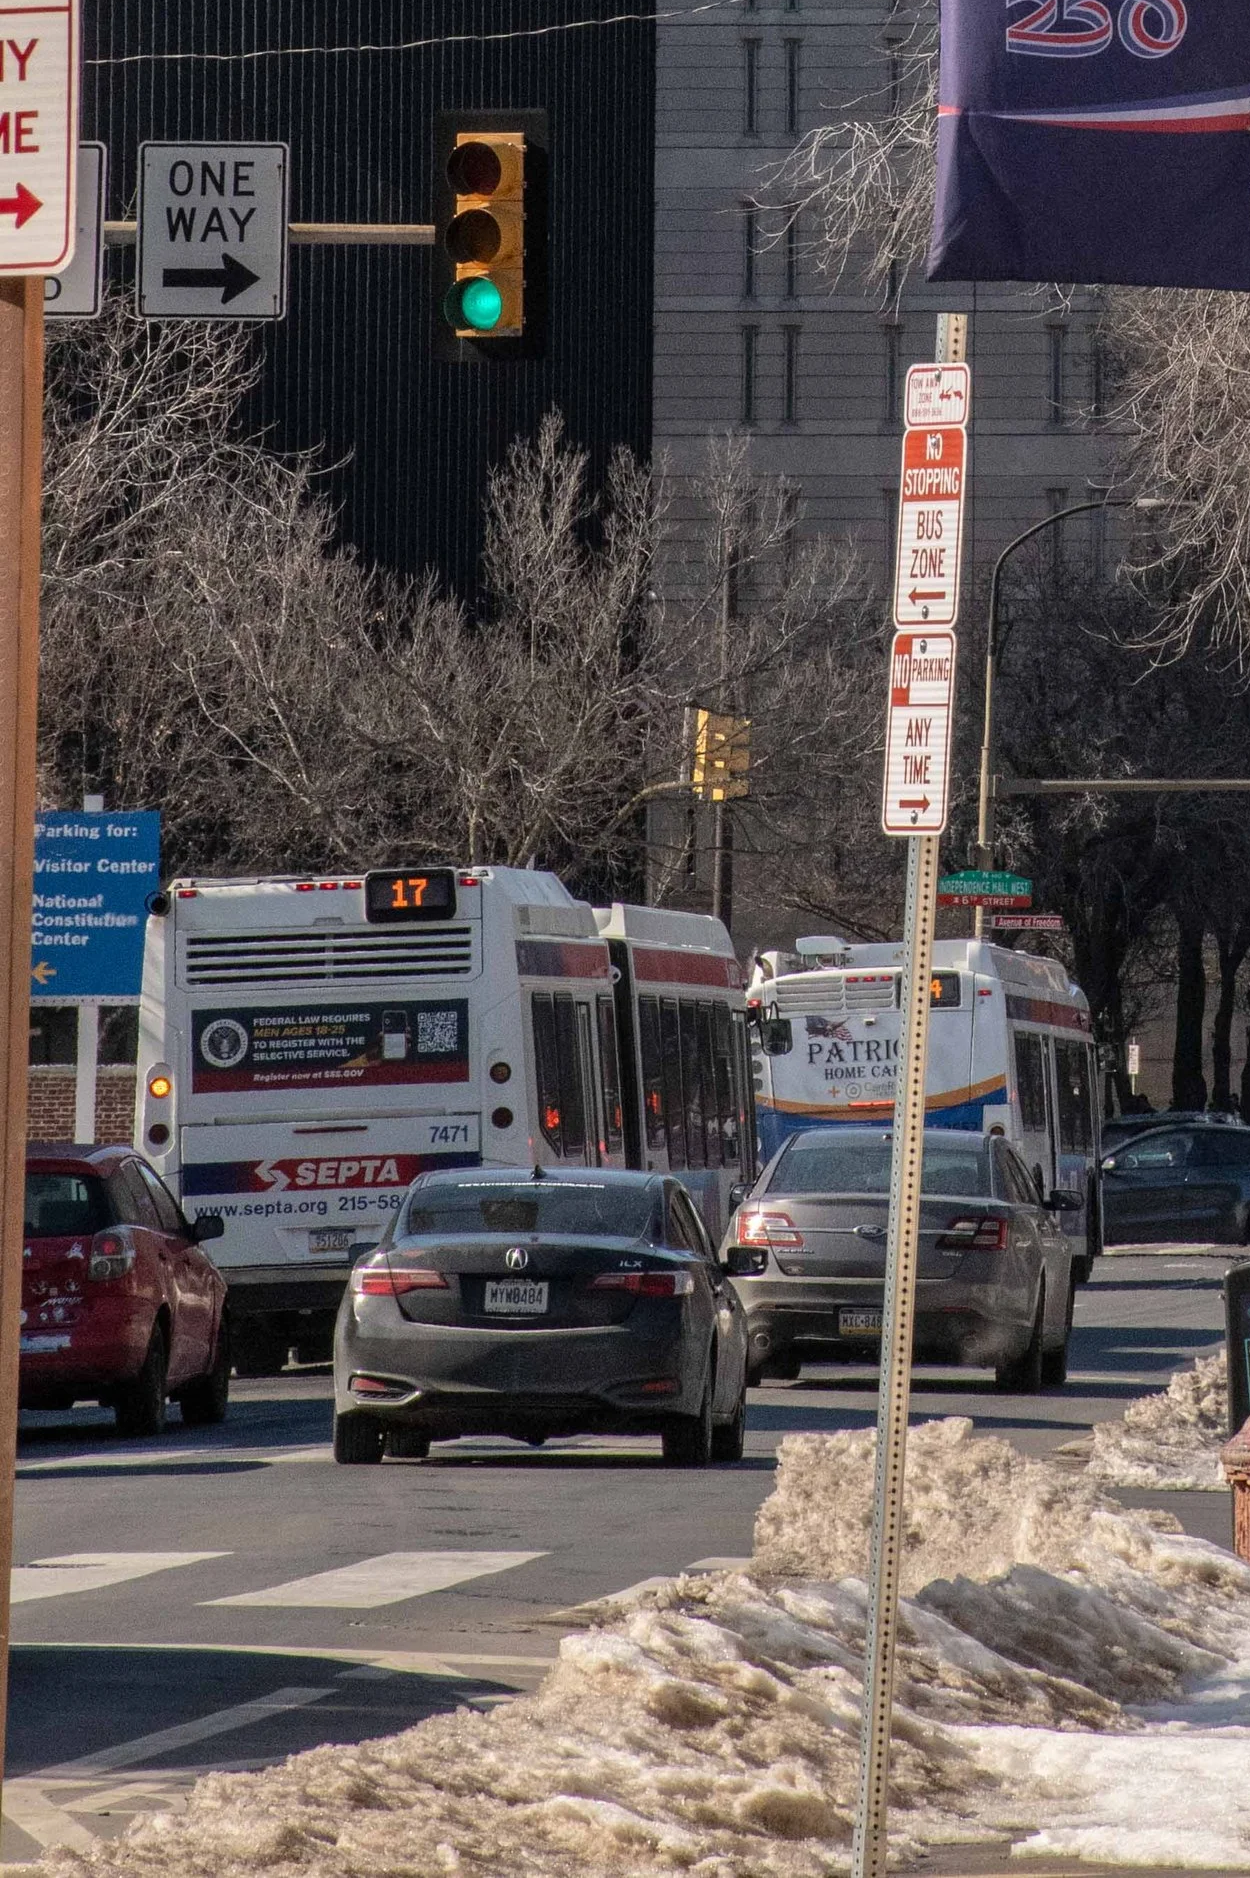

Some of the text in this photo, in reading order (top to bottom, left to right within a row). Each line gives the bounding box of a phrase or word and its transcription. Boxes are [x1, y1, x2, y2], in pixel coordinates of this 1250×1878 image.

[0, 39, 39, 82] Y
[168, 161, 255, 198] ONE
[166, 207, 257, 243] WAY
[926, 433, 943, 460] NO
[905, 467, 960, 496] STOPPING
[916, 510, 943, 540] BUS
[910, 548, 946, 578] ZONE
[893, 653, 909, 689] NO
[912, 657, 950, 682] PARKING
[905, 718, 932, 747] ANY
[903, 755, 931, 784] TIME
[33, 824, 137, 839] Parking for:
[33, 859, 155, 873] Visitor Center
[392, 878, 427, 907] 17
[938, 881, 1028, 894] INDEPENDENCE MALL WEST
[32, 894, 103, 908] National
[982, 897, 1015, 905] STREET
[31, 912, 139, 927] Constitution
[31, 931, 89, 945] Center
[253, 1013, 371, 1026] FEDERAL LAW REQUIRES
[253, 1028, 279, 1037] MEN
[281, 1026, 312, 1036] AGES
[253, 1036, 365, 1049] TO REGISTER WITH THE
[252, 1048, 350, 1061] SELECTIVE SERVICE.
[253, 1072, 290, 1082] Register
[292, 1072, 311, 1080] now
[825, 1066, 866, 1080] HOME
[429, 1125, 469, 1143] 7471
[295, 1158, 400, 1186] SEPTA
[193, 1194, 402, 1219] www.septa.org 215-58
